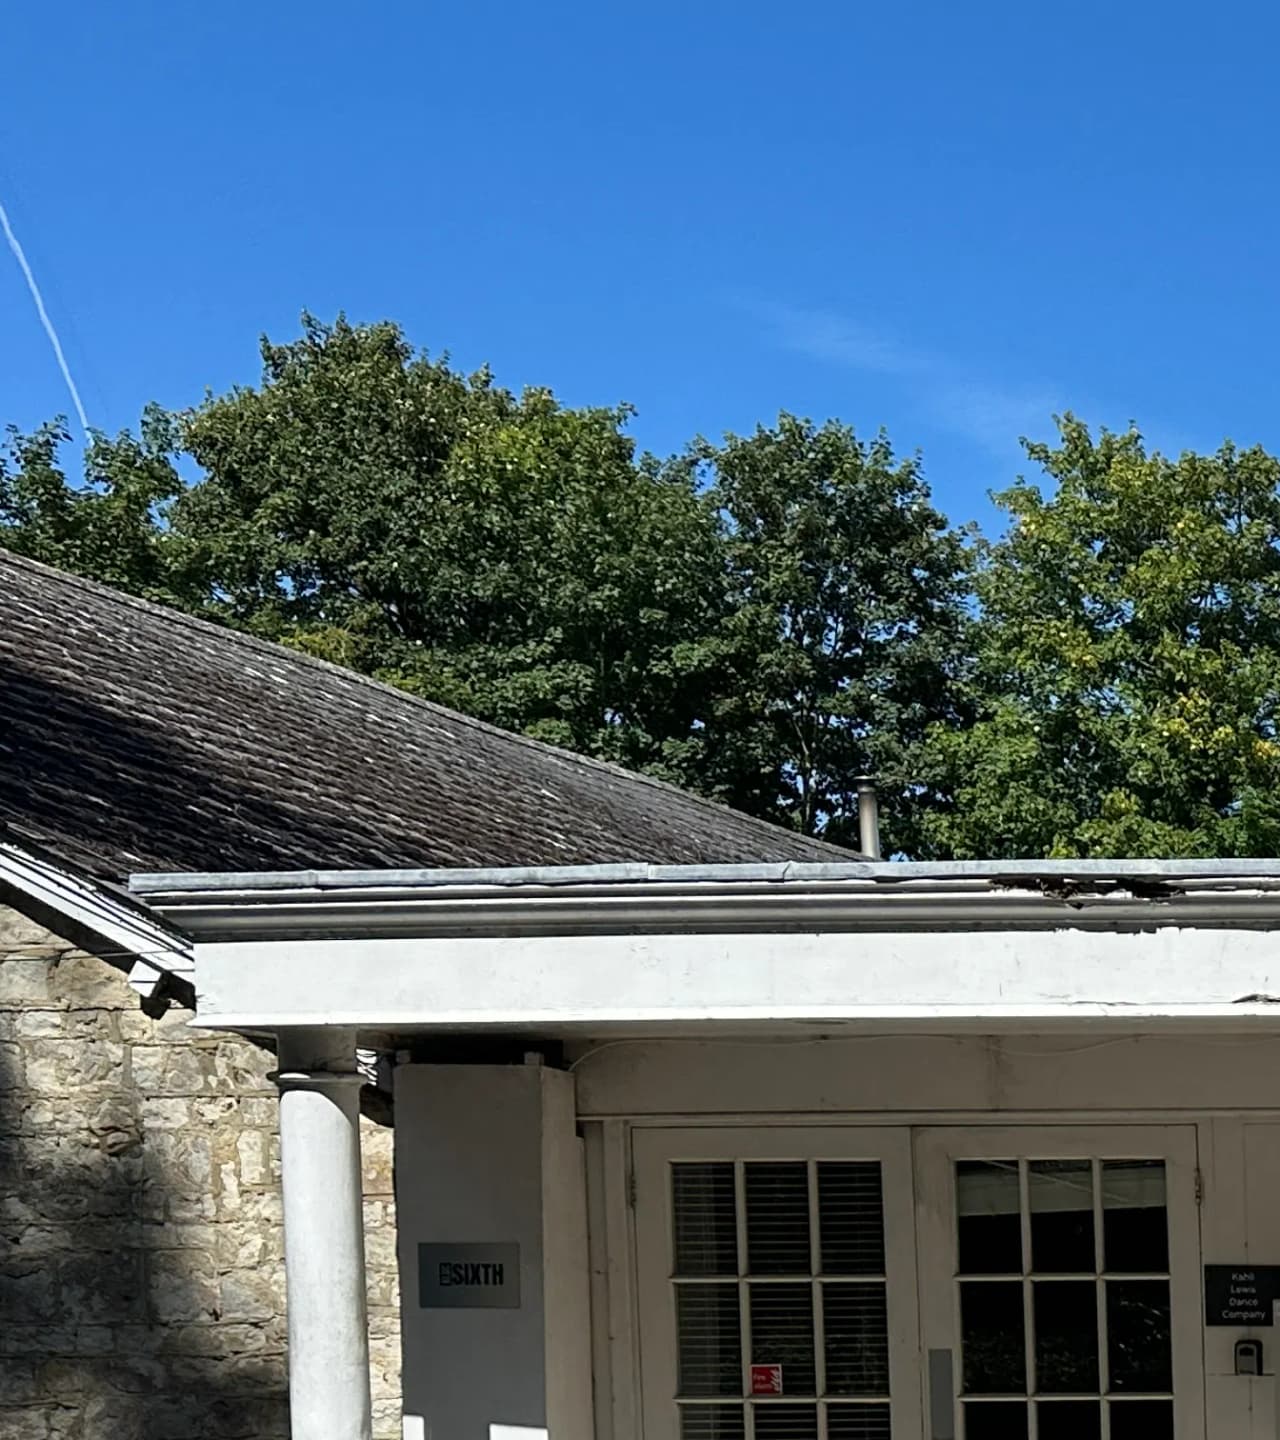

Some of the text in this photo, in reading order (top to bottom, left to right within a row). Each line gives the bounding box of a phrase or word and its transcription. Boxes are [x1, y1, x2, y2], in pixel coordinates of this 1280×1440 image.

[453, 1262, 504, 1286] SIXTH
[1228, 1297, 1259, 1307] Dance
[1222, 1309, 1266, 1321] Company
